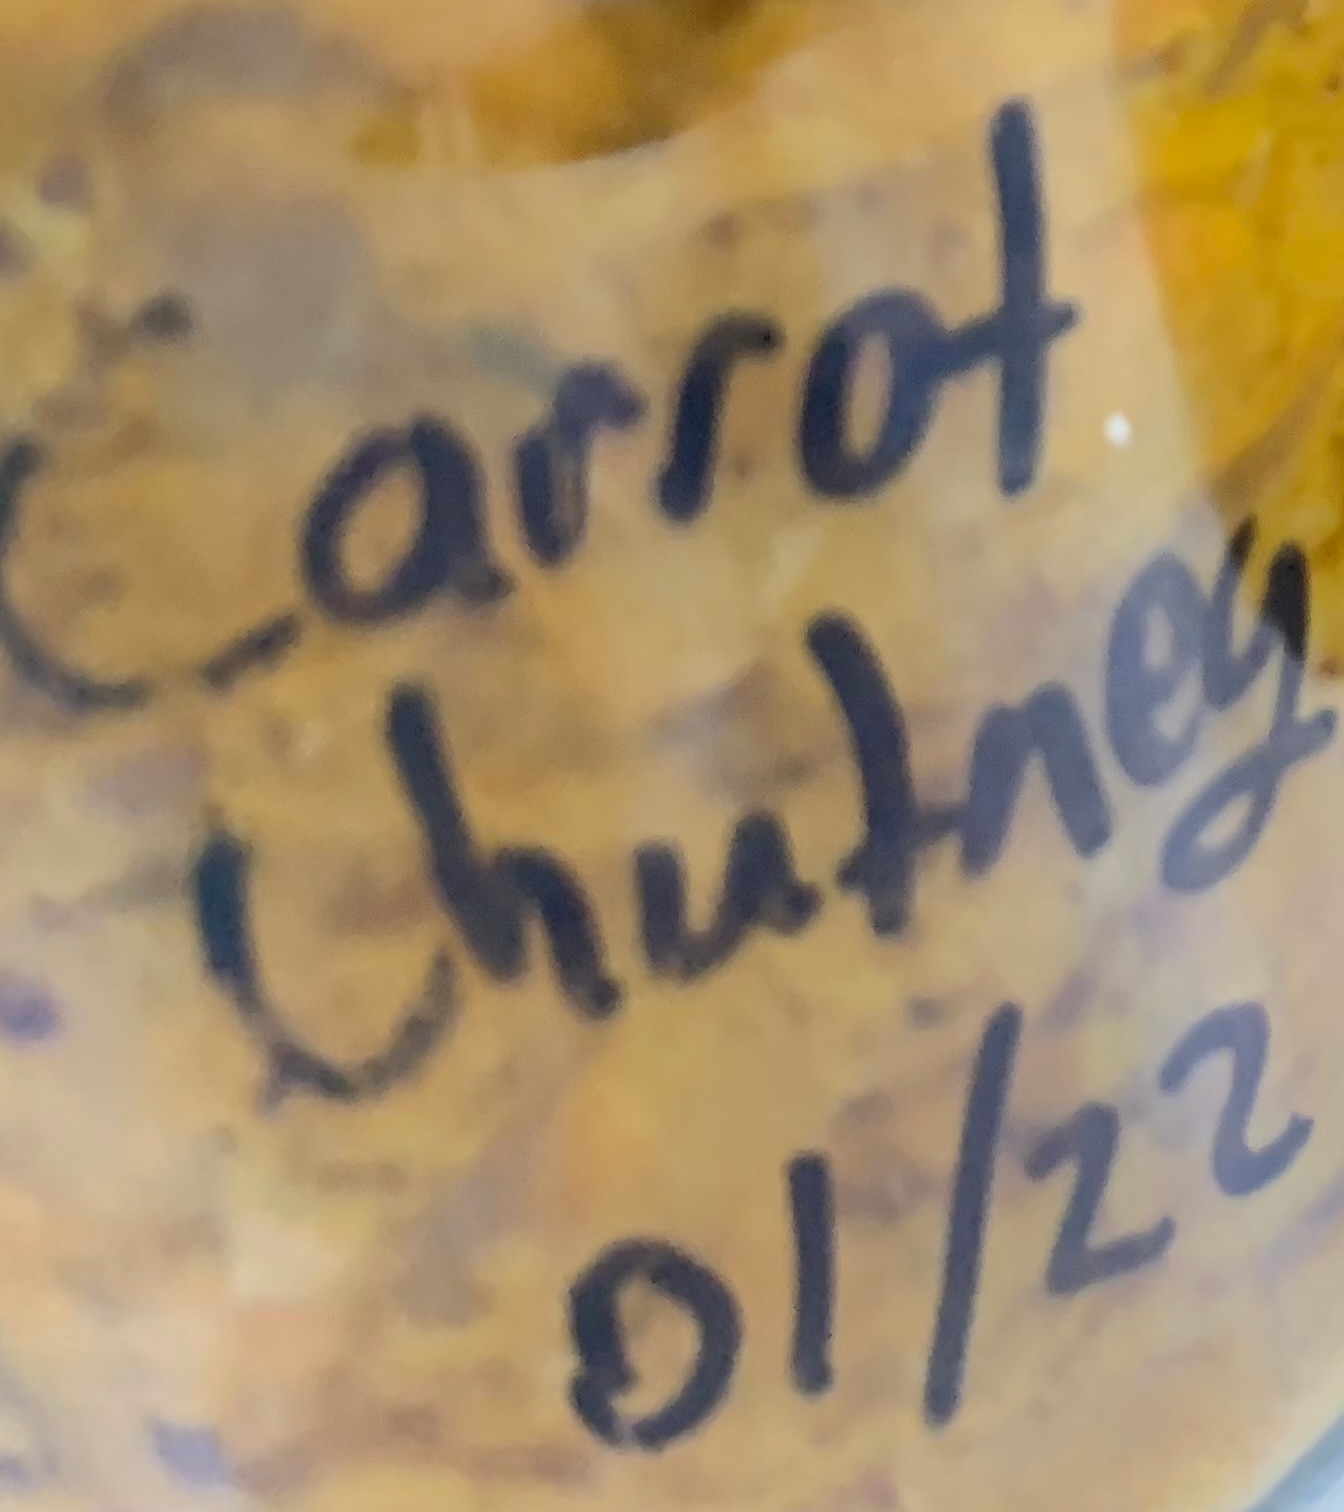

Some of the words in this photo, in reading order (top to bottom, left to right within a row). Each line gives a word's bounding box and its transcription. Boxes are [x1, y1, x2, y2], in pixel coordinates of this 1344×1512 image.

[0, 98, 1079, 707] Carrot
[193, 517, 1336, 1103] Chutney
[567, 1000, 1314, 1454] 01/22
